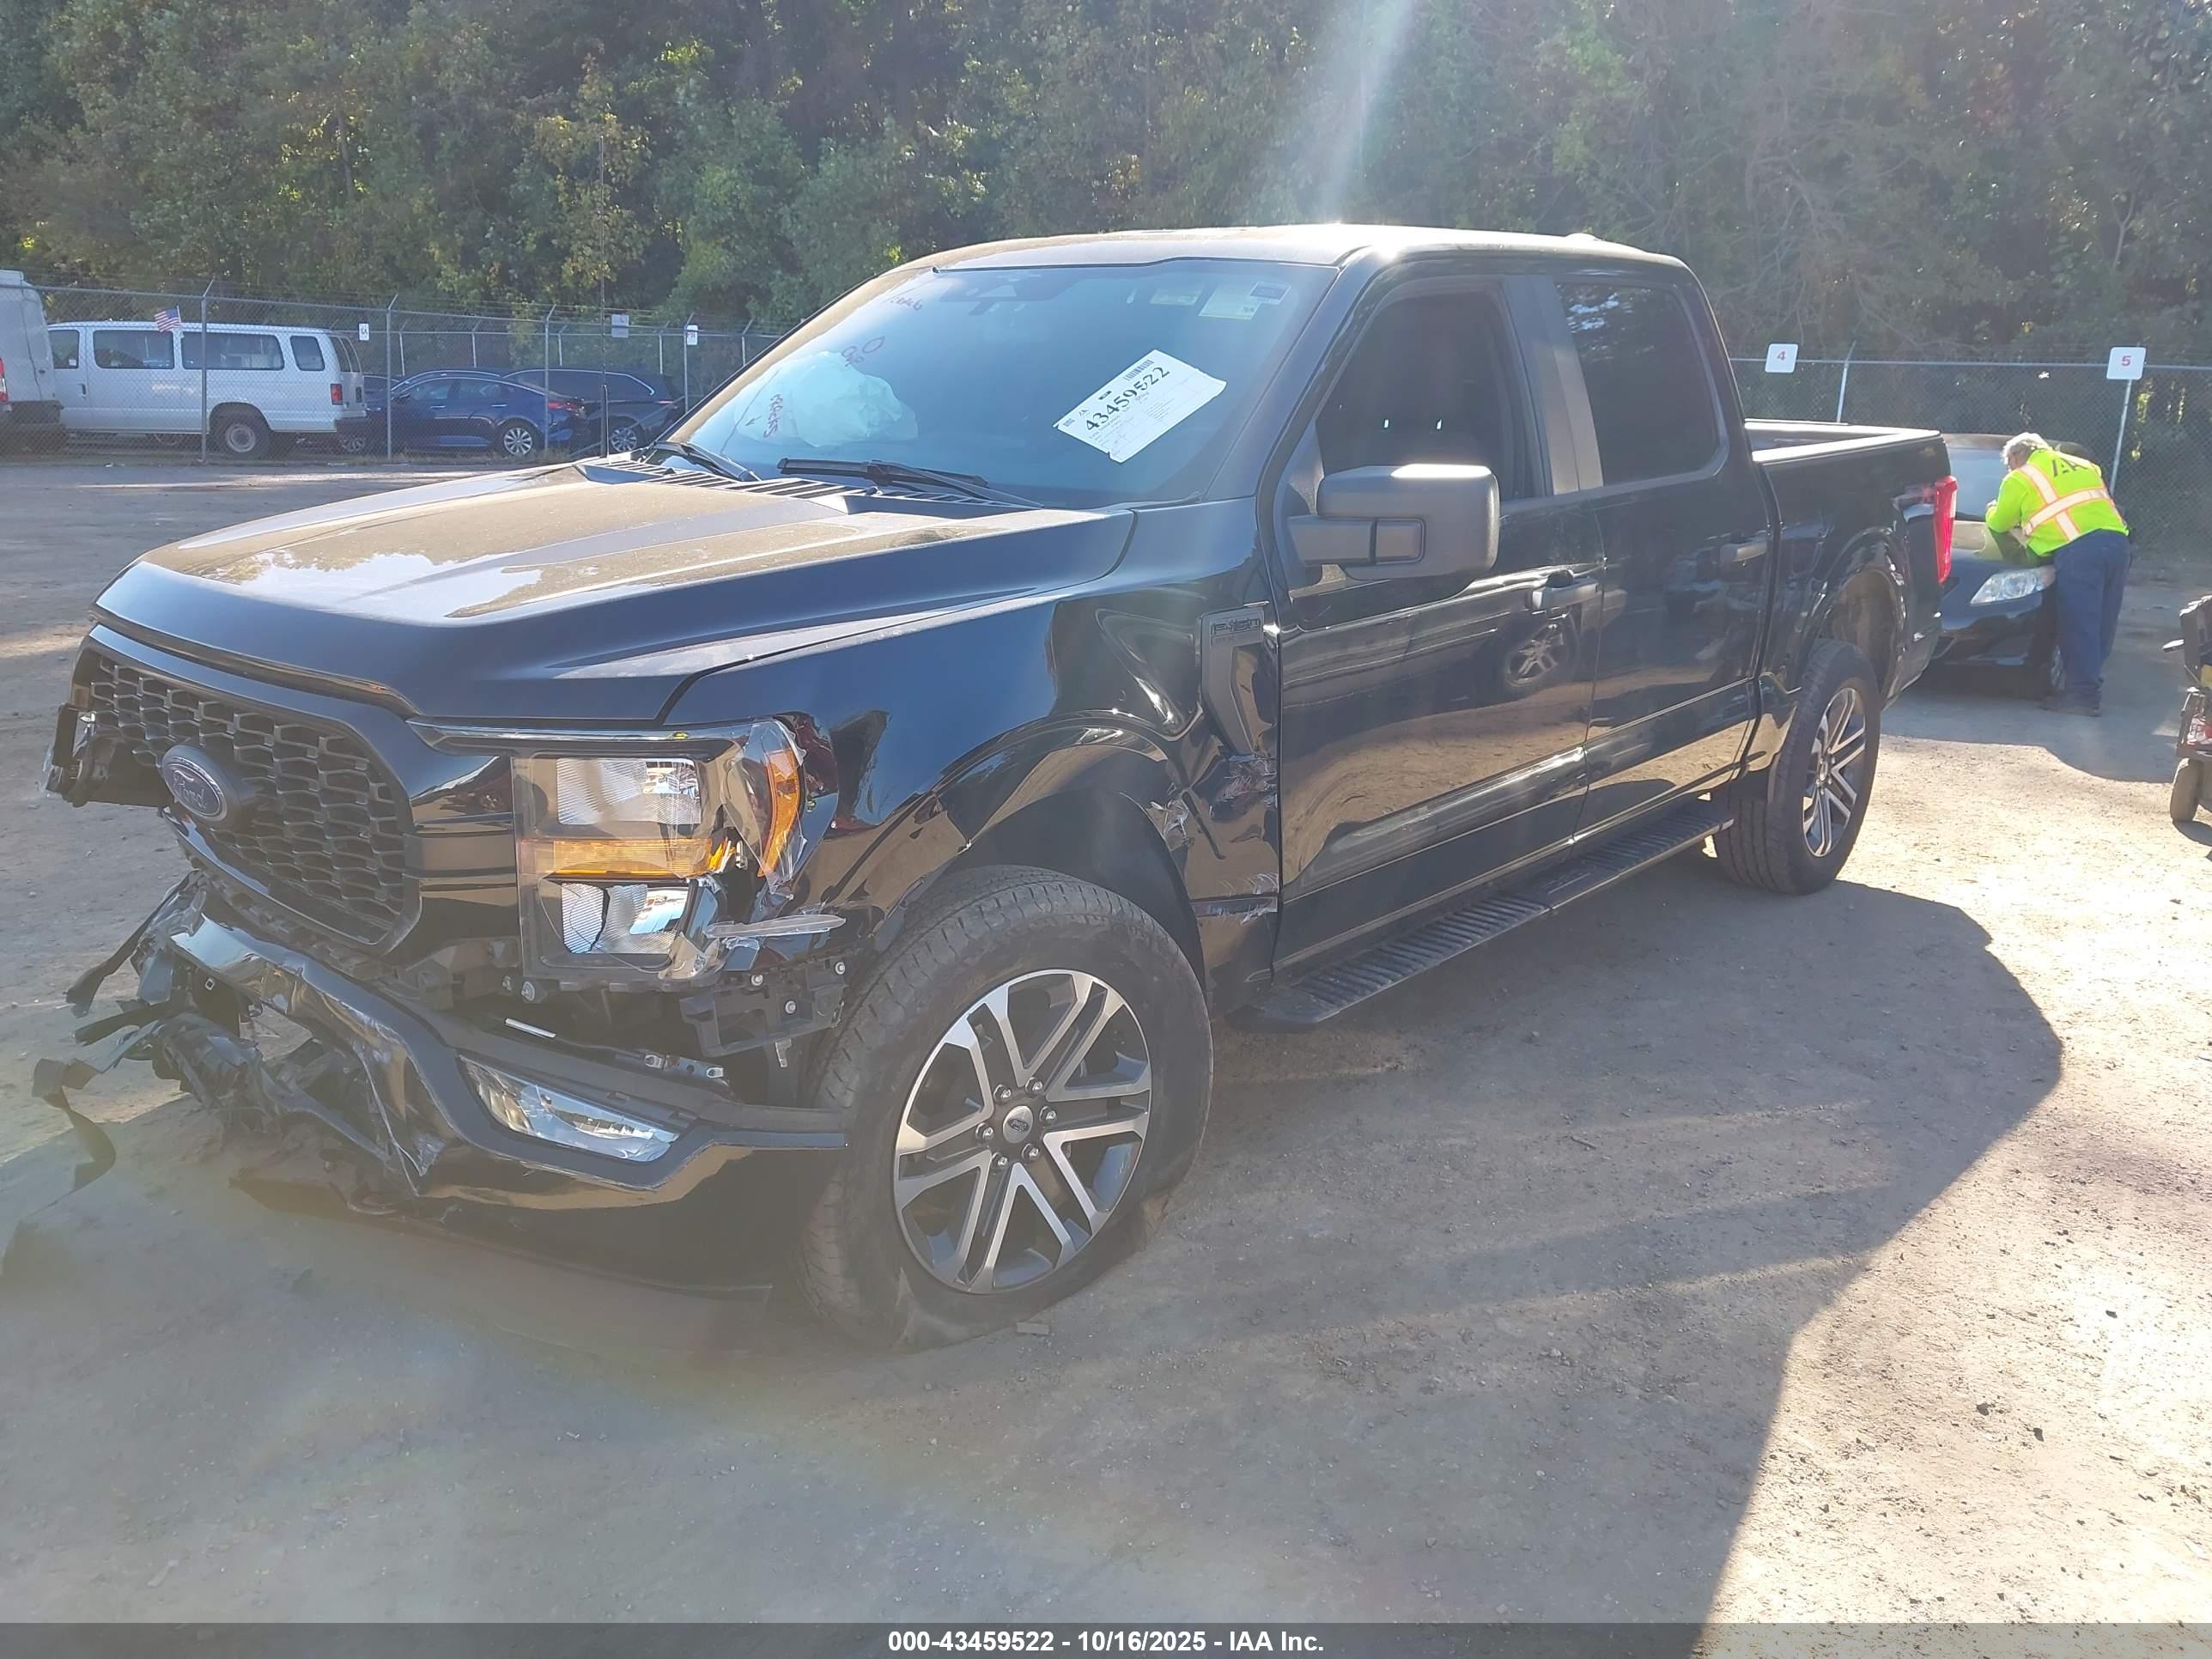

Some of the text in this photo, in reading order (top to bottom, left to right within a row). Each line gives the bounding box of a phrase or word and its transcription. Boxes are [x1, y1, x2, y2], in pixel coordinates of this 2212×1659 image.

[1777, 350, 1786, 361] 4
[2122, 356, 2131, 367] 5
[1085, 367, 1170, 431] 43459522
[1210, 617, 1261, 636] F-150
[173, 769, 207, 810] Ford
